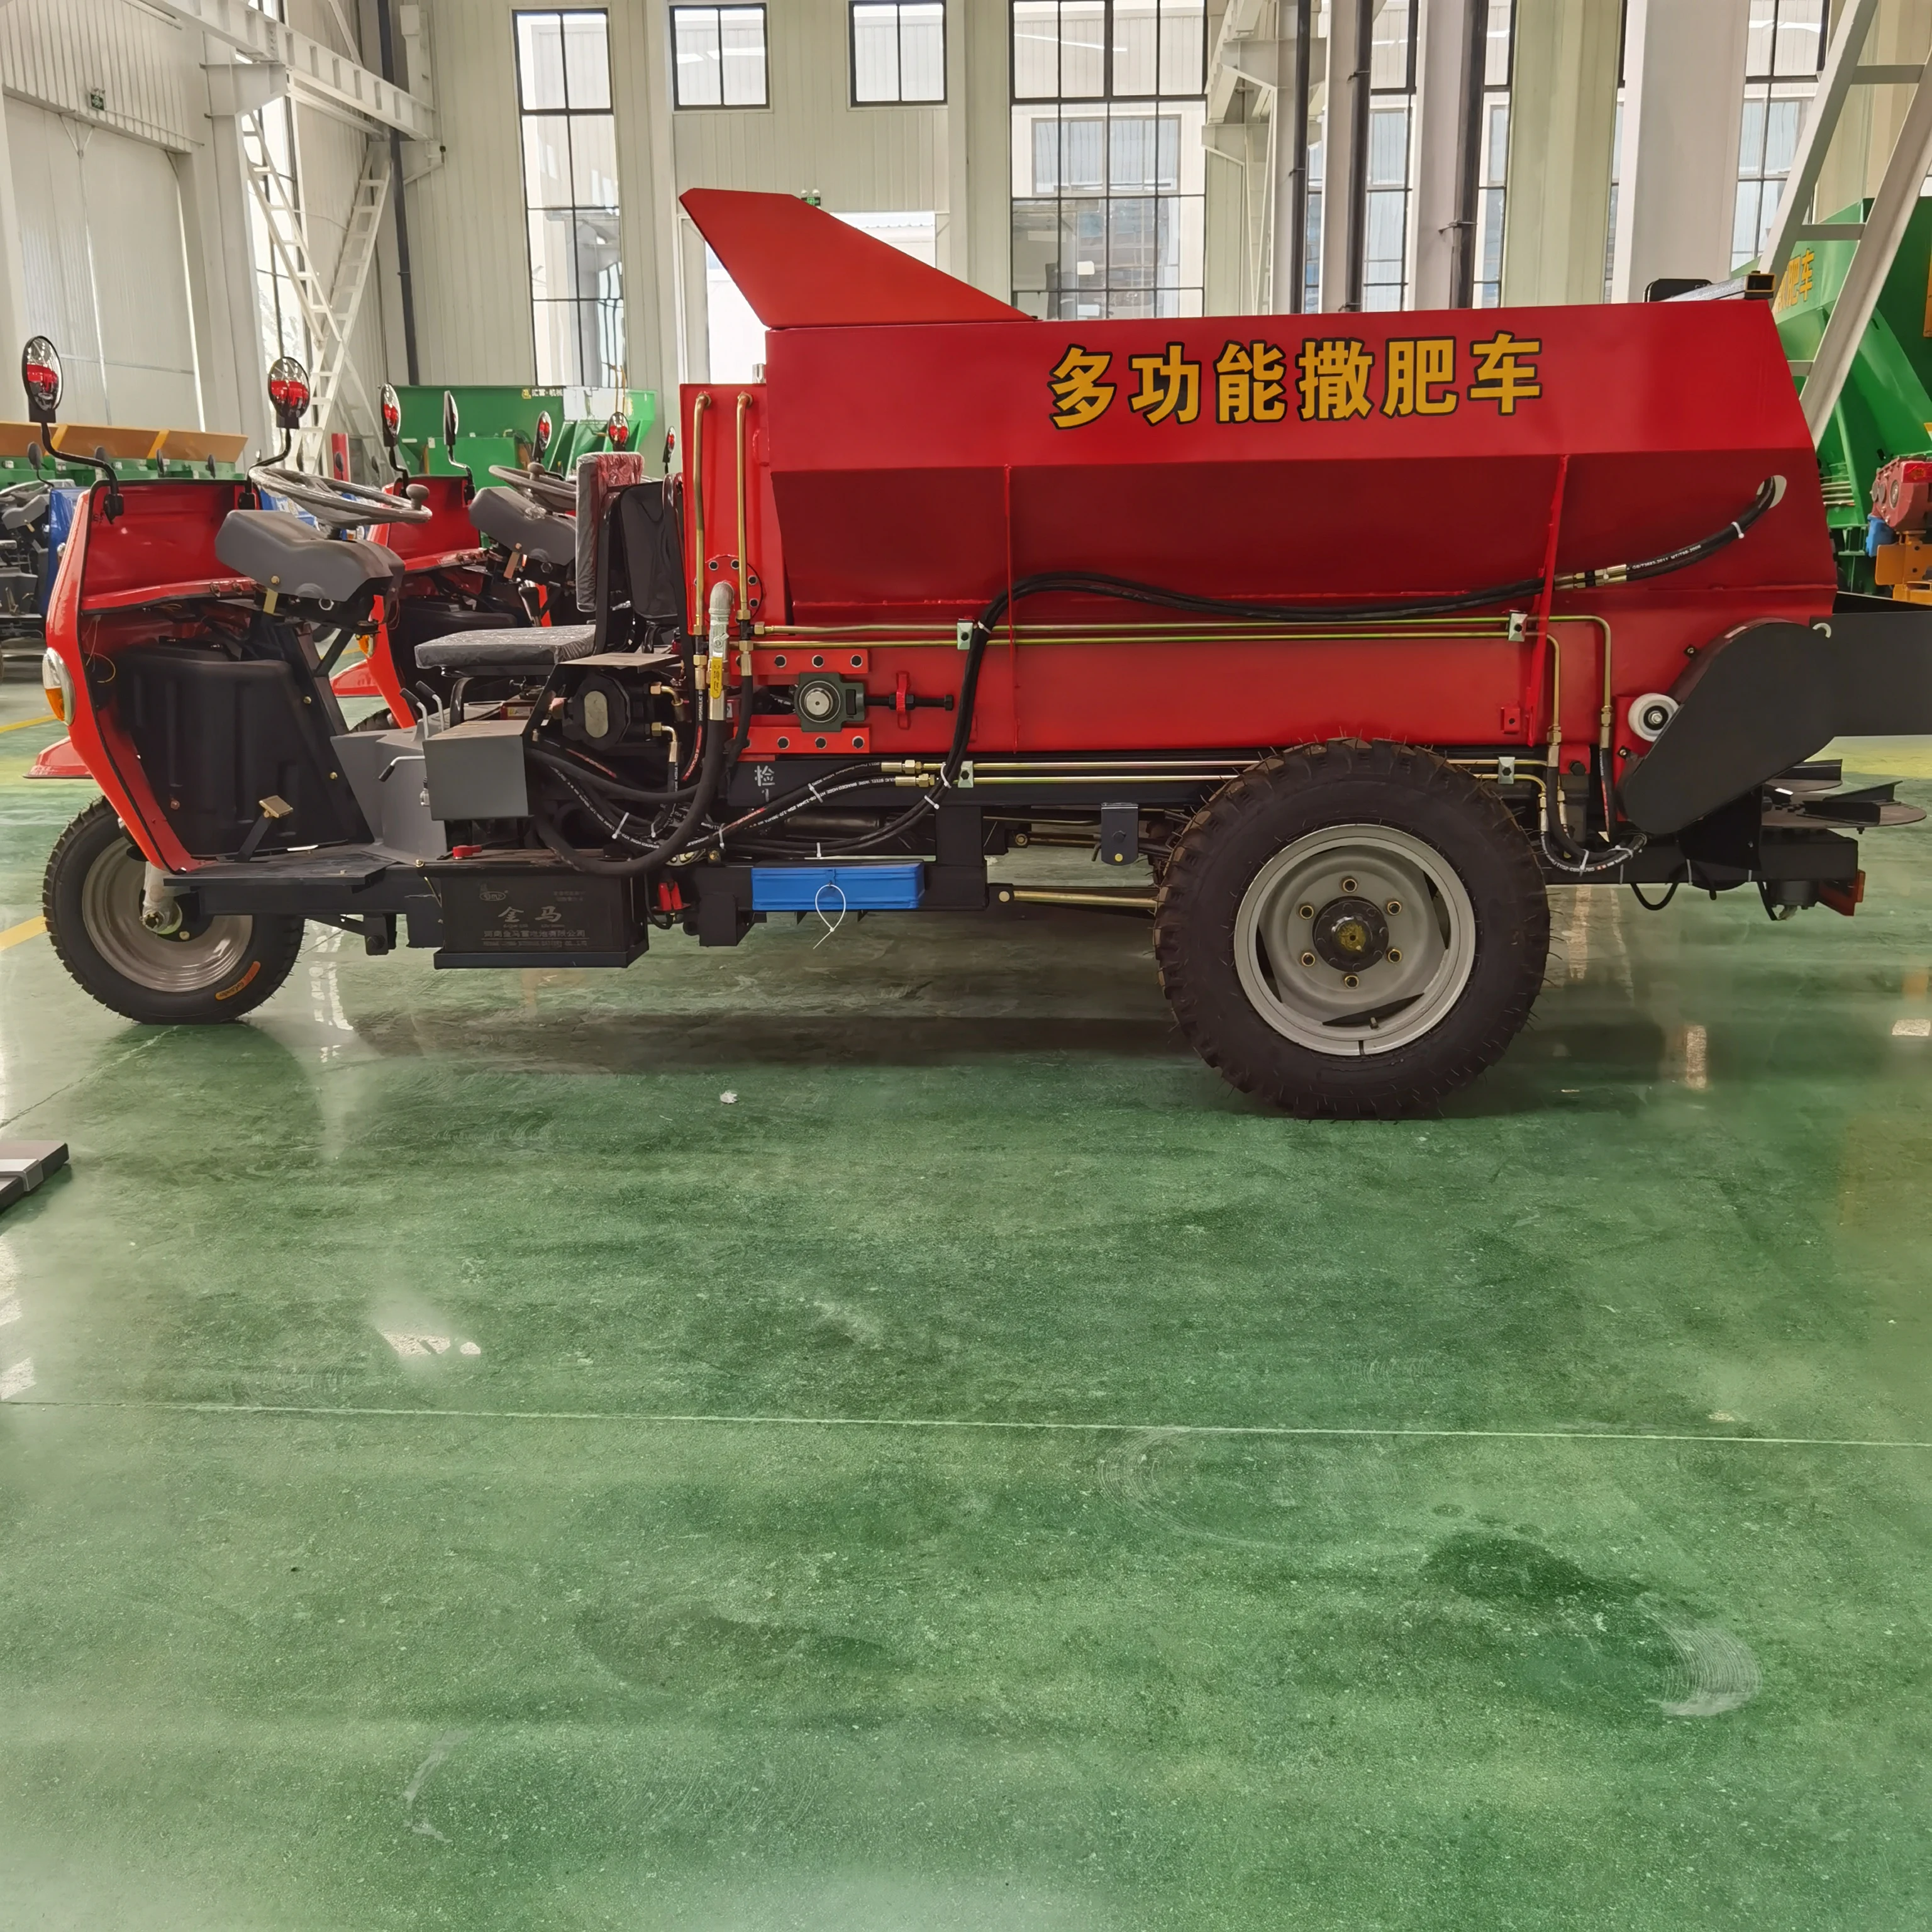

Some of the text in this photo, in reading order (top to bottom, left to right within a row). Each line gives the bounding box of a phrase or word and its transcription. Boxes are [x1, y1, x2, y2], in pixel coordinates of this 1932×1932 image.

[1048, 331, 1543, 430] 多功能撒肥车
[754, 765, 775, 787] 检
[498, 906, 562, 923] 金马
